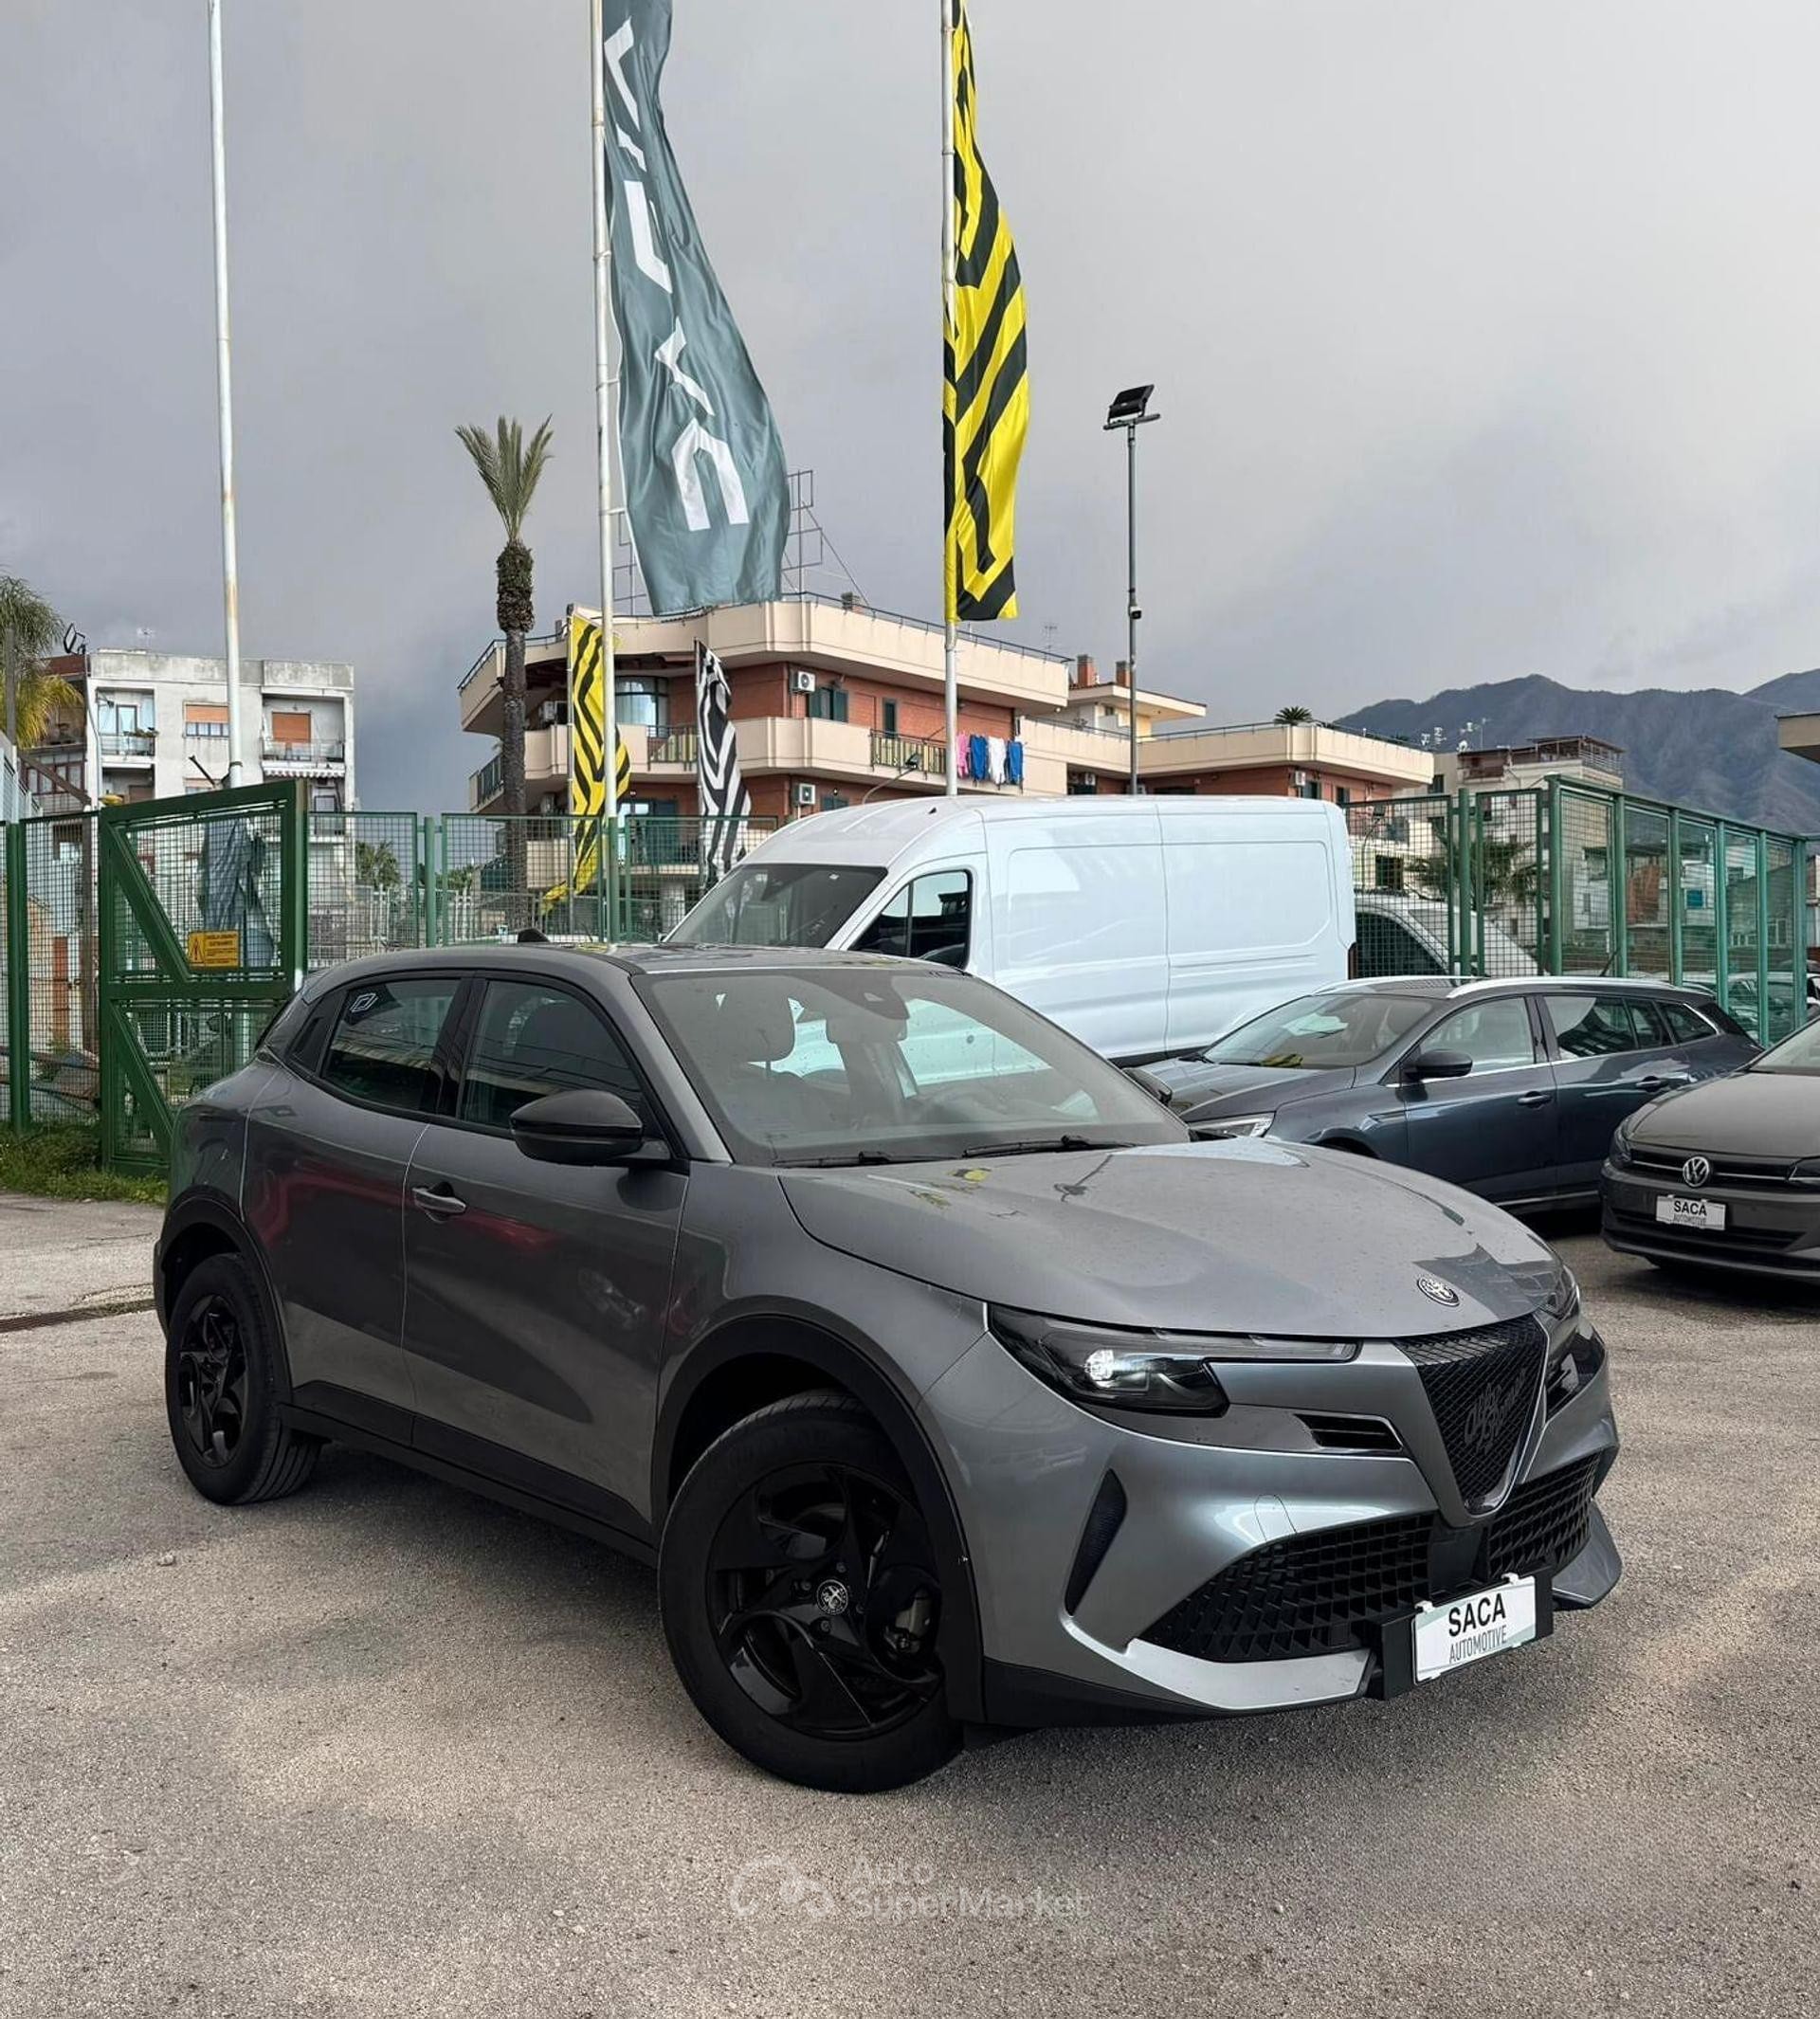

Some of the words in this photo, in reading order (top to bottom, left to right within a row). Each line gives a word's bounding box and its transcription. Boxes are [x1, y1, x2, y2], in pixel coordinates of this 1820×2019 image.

[1673, 1200, 1707, 1216] SACA
[1448, 1592, 1506, 1637] SACA
[1448, 1624, 1507, 1664] AUTOMOTIVE
